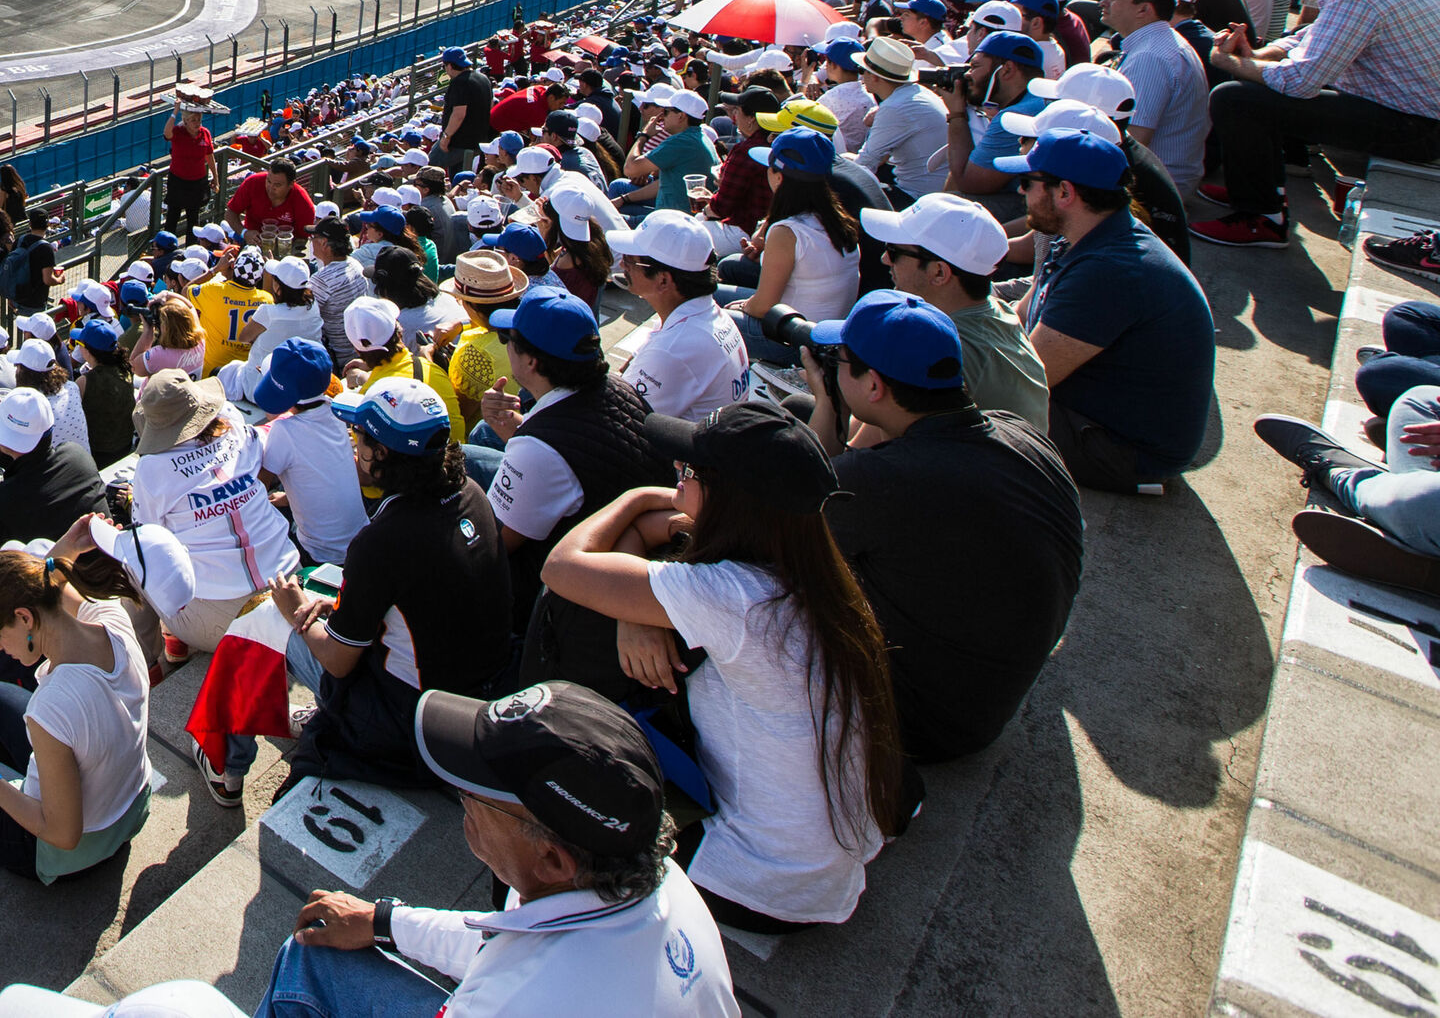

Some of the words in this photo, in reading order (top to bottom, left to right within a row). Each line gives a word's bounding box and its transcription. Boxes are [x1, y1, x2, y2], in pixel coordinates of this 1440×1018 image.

[9, 64, 51, 76] Bär
[223, 297, 246, 307] Team
[365, 419, 380, 436] NEC
[170, 441, 223, 472] JOHNNIE
[545, 780, 607, 822] ENDURANCE
[603, 816, 631, 833] 24
[303, 786, 385, 853] 19
